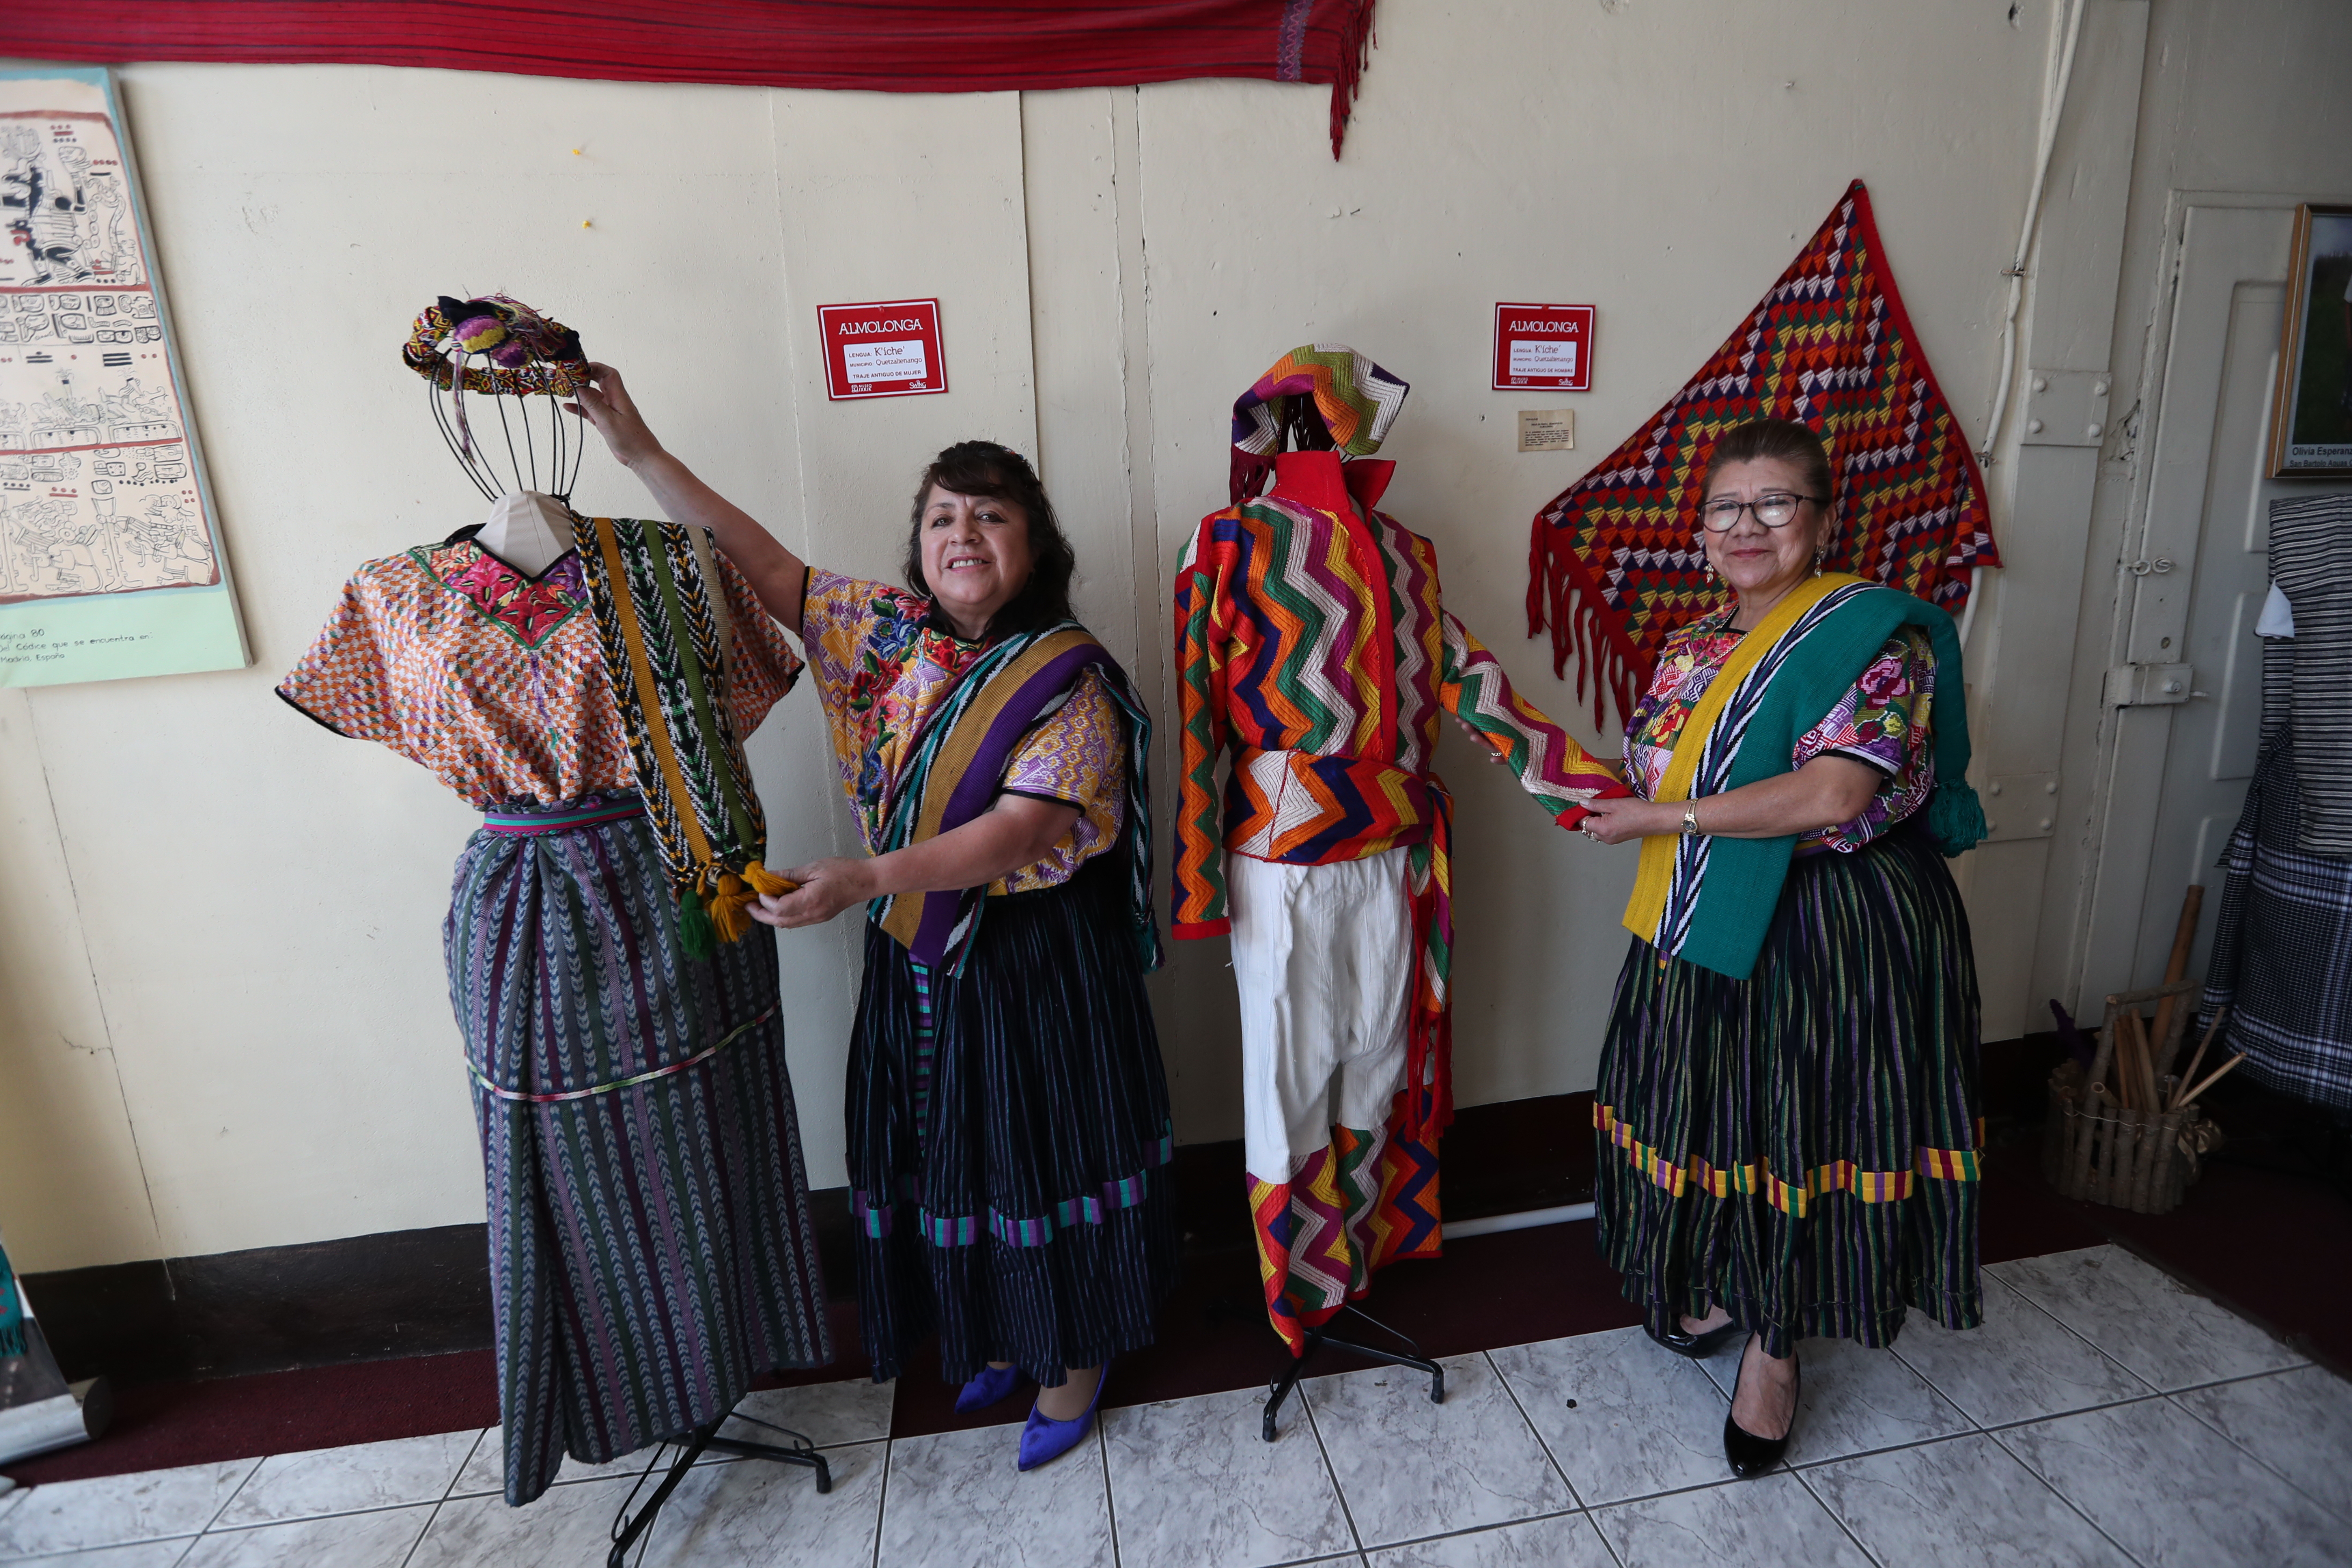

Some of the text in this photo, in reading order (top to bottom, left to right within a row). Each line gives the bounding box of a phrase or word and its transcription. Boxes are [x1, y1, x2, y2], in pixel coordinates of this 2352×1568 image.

[838, 319, 923, 335] ALMOLONGA
[1508, 320, 1579, 333] ALMOLONGA
[876, 357, 923, 366] Quetzaltenango
[2292, 446, 2315, 456] Olivia
[0, 628, 45, 644] ágina 80
[16, 642, 47, 650] Códice
[52, 641, 69, 652] que
[89, 634, 135, 645] encuentra
[36, 653, 65, 662] España
